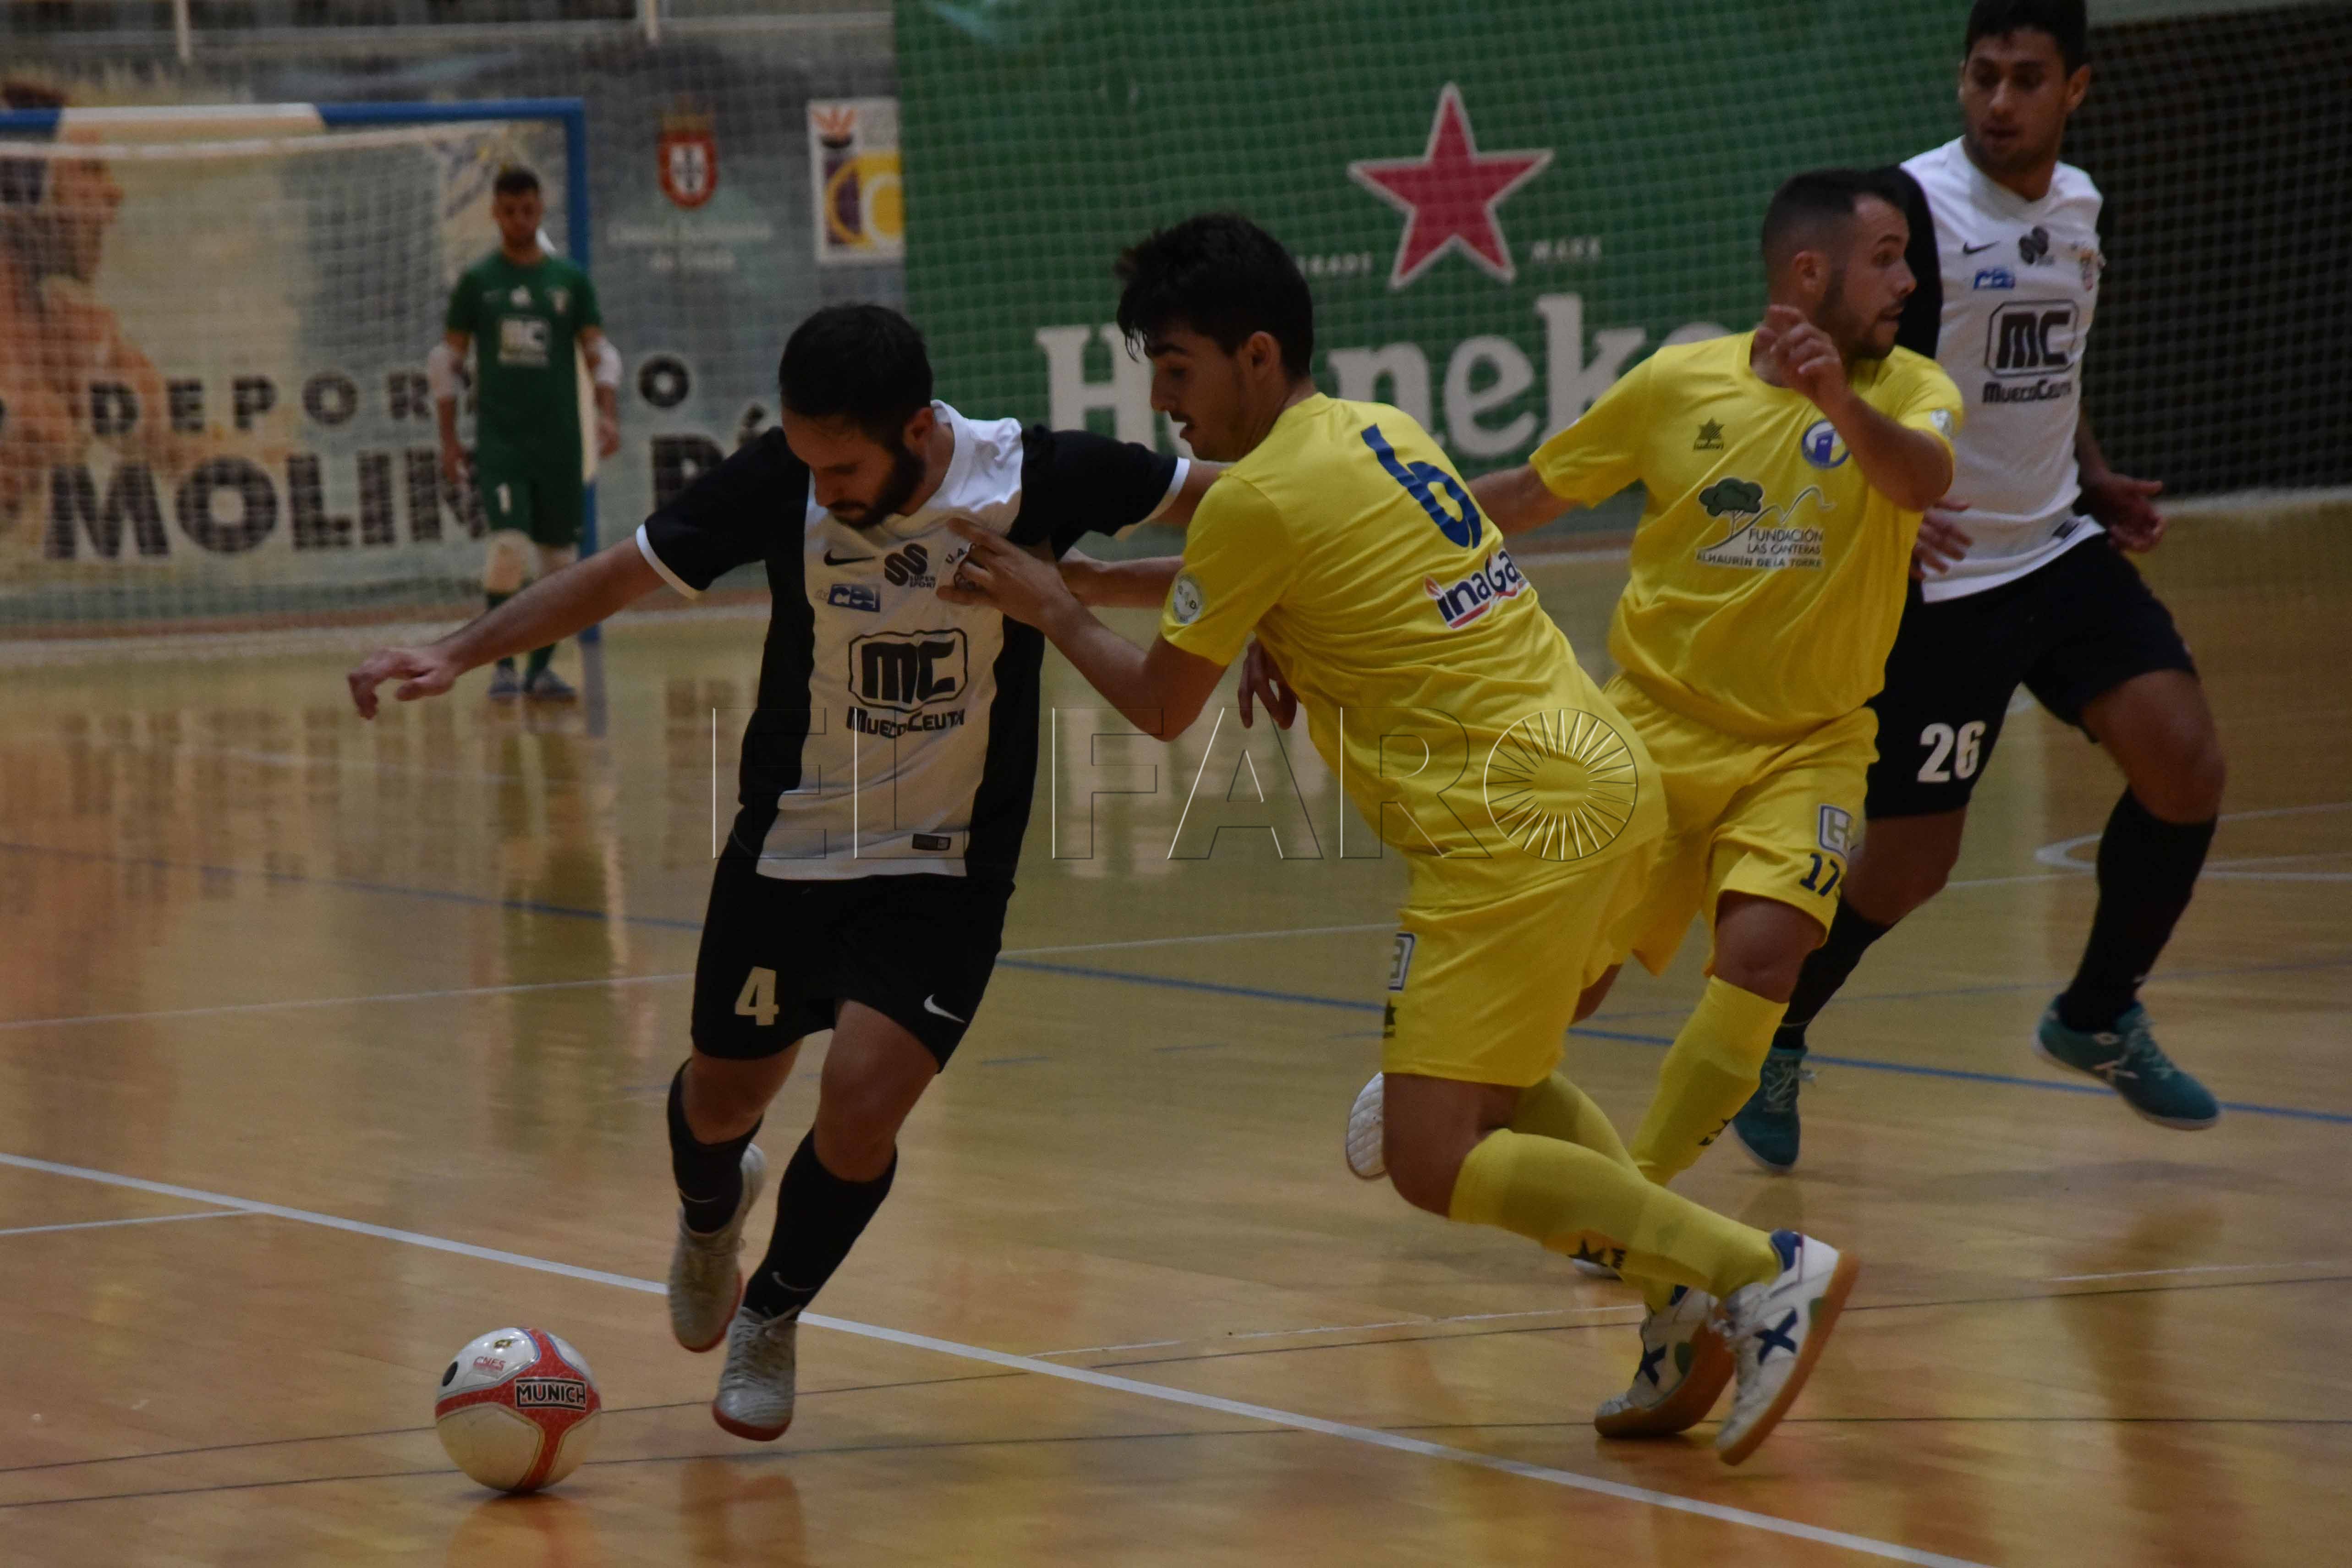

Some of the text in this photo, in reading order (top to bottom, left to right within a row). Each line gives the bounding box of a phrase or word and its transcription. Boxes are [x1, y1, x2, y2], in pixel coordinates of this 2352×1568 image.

[43, 450, 489, 560] MOLIN
[1916, 720, 1987, 784] 26
[1800, 852, 1840, 897] 17
[734, 965, 779, 1026] 4
[516, 1384, 586, 1404] MUNICH
